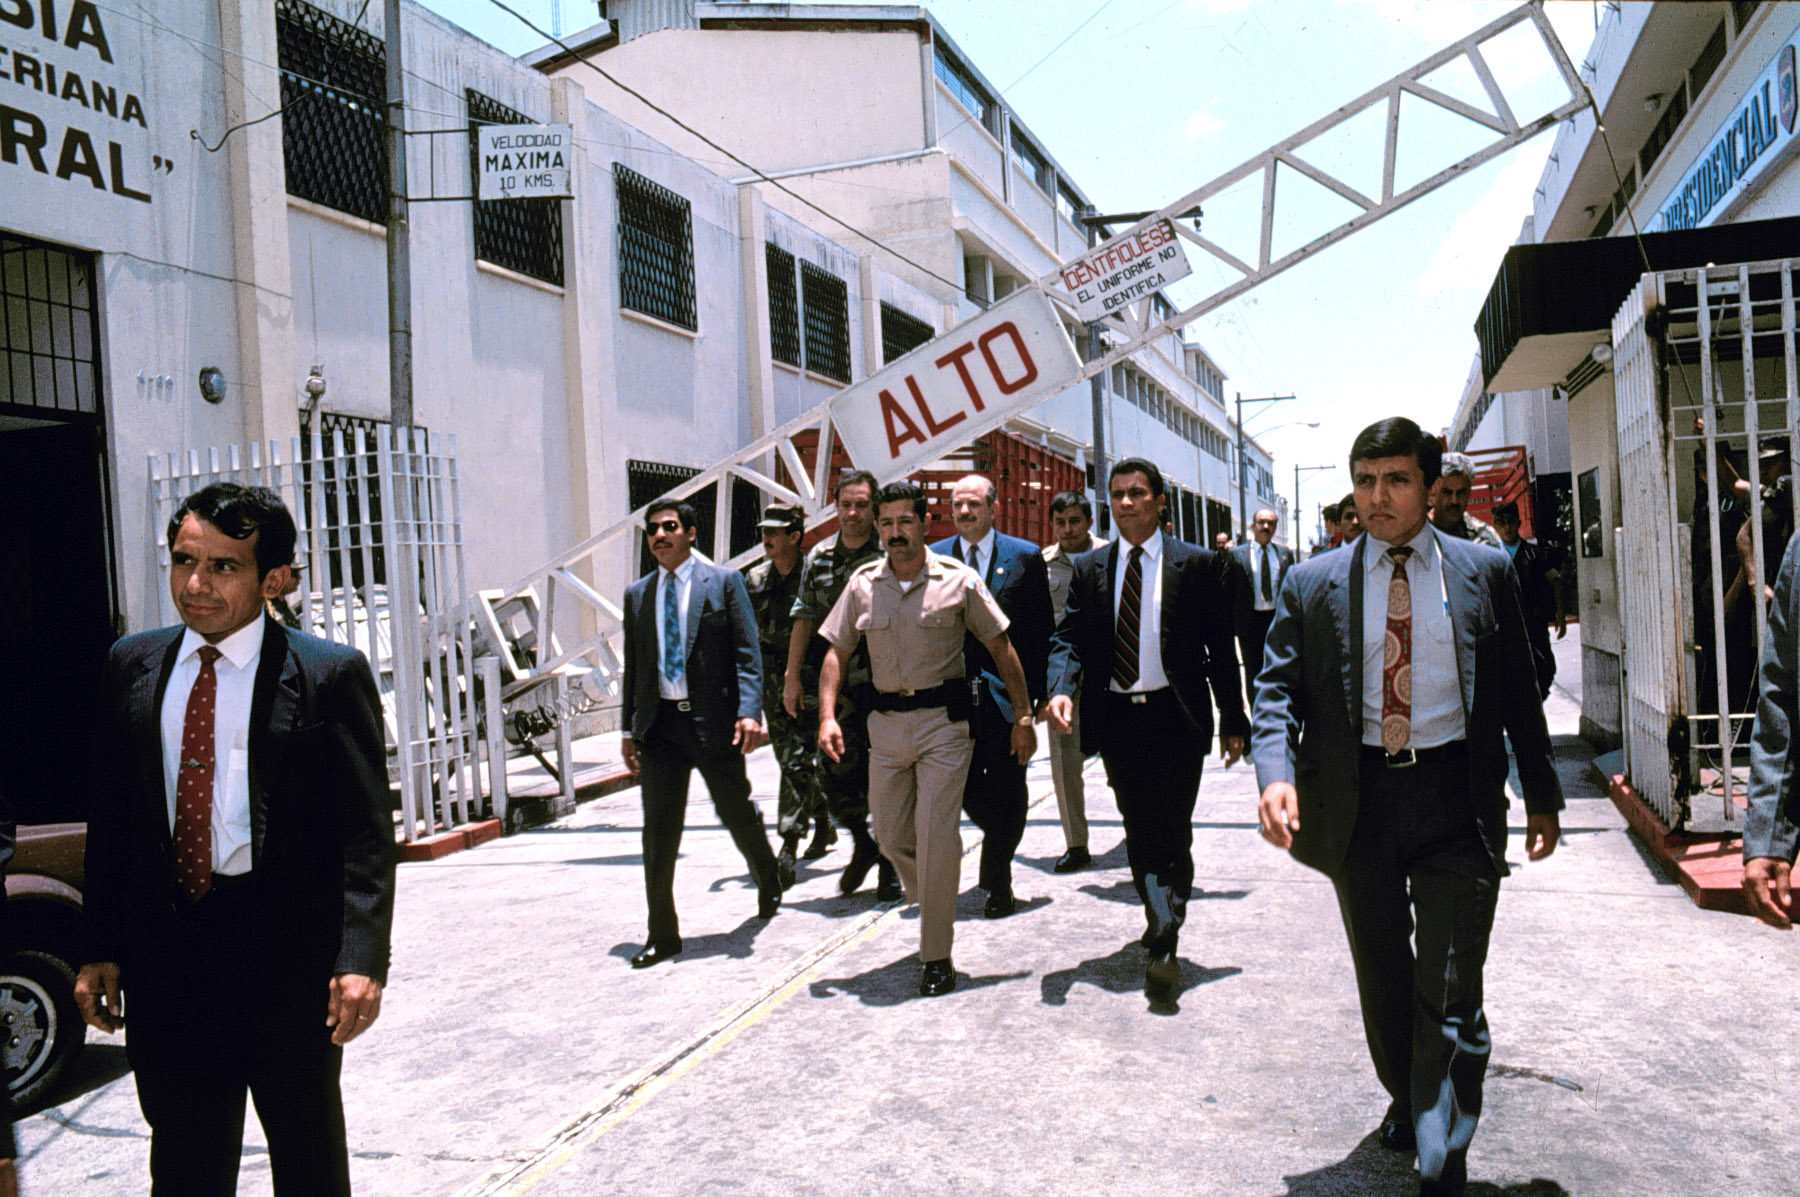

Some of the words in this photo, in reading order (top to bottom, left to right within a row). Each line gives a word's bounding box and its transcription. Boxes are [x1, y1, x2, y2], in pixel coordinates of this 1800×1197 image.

[491, 134, 562, 149] VELOCIDAD
[485, 150, 564, 172] MAXIMA
[500, 175, 516, 191] 10
[1076, 288, 1095, 304] EL
[1097, 257, 1156, 293] UNIFORME
[1158, 245, 1177, 263] NO
[1102, 272, 1166, 311] IDENTIFICA
[878, 321, 1038, 459] ALTO
